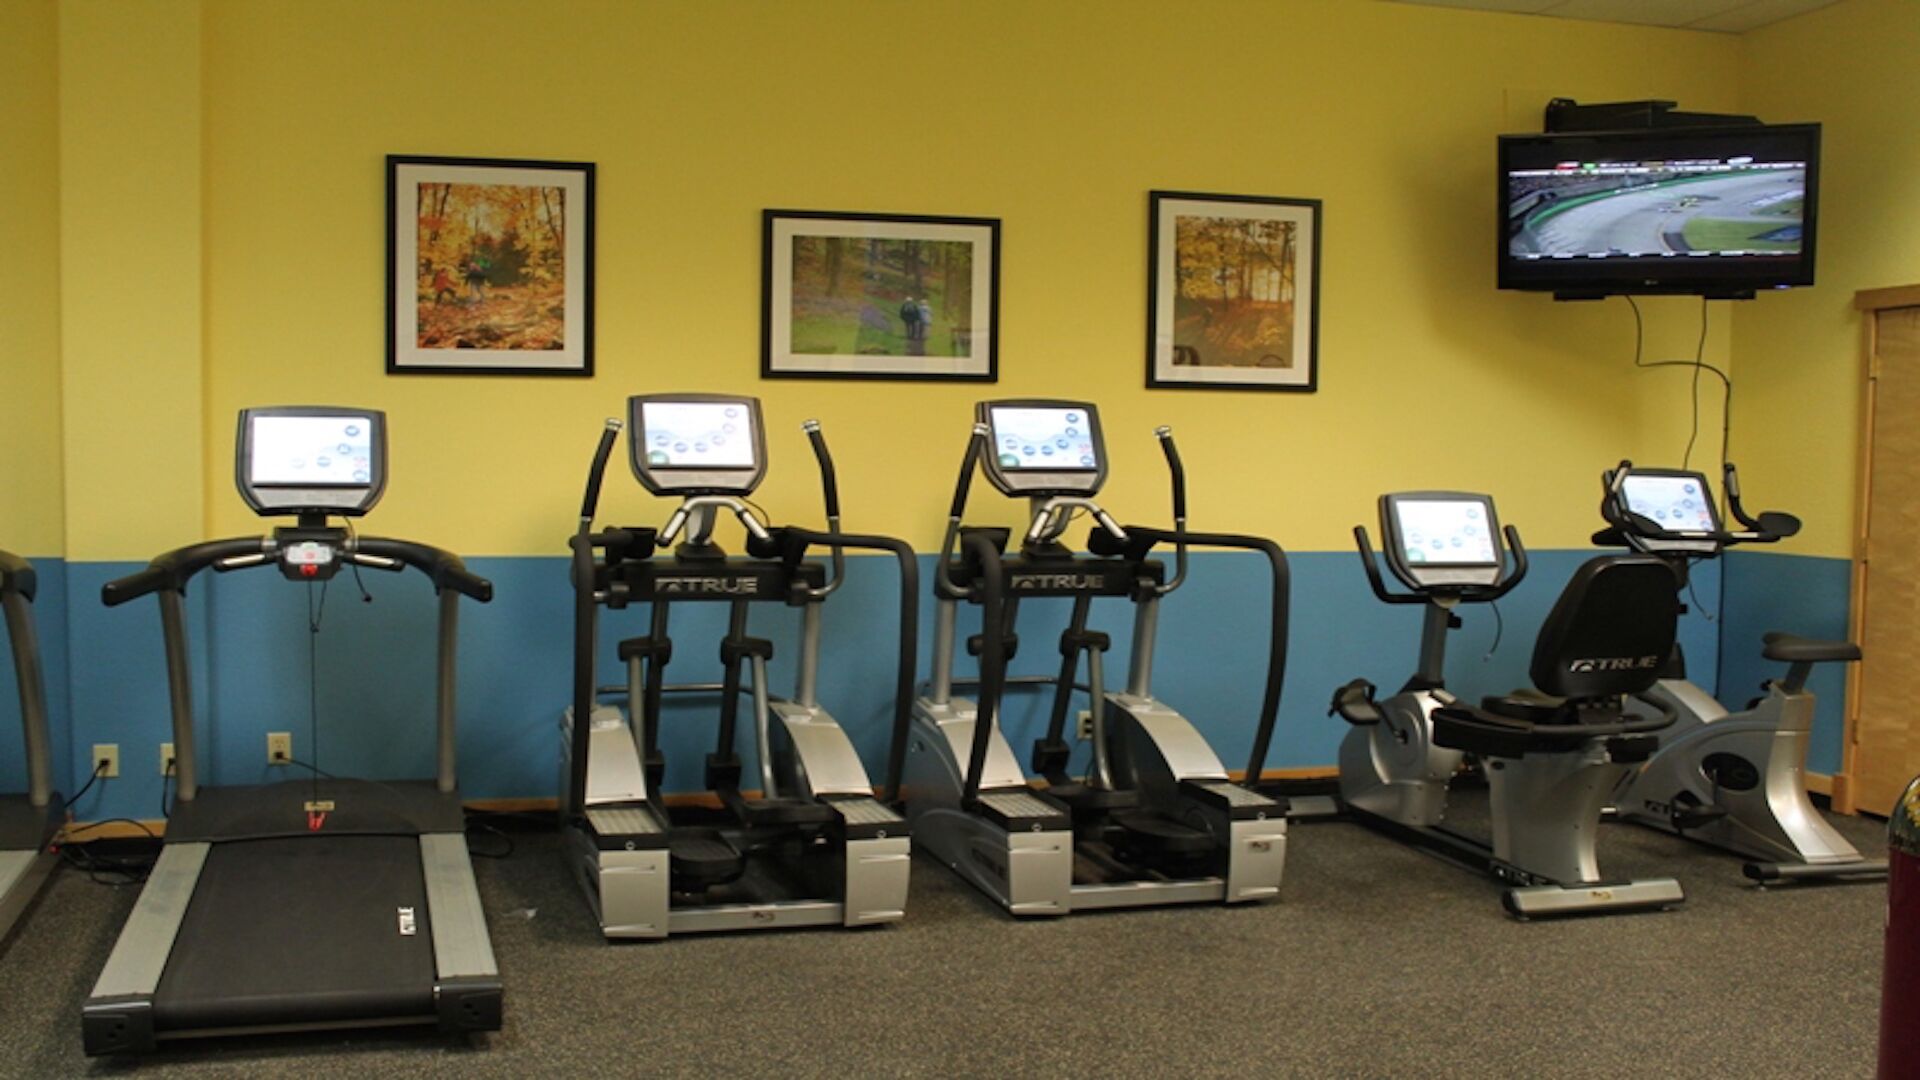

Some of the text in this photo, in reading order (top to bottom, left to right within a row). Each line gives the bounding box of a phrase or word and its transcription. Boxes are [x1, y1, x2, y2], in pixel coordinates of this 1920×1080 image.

[682, 576, 758, 593] TRUE
[1036, 574, 1104, 589] TRUE
[1597, 655, 1658, 671] TRUE
